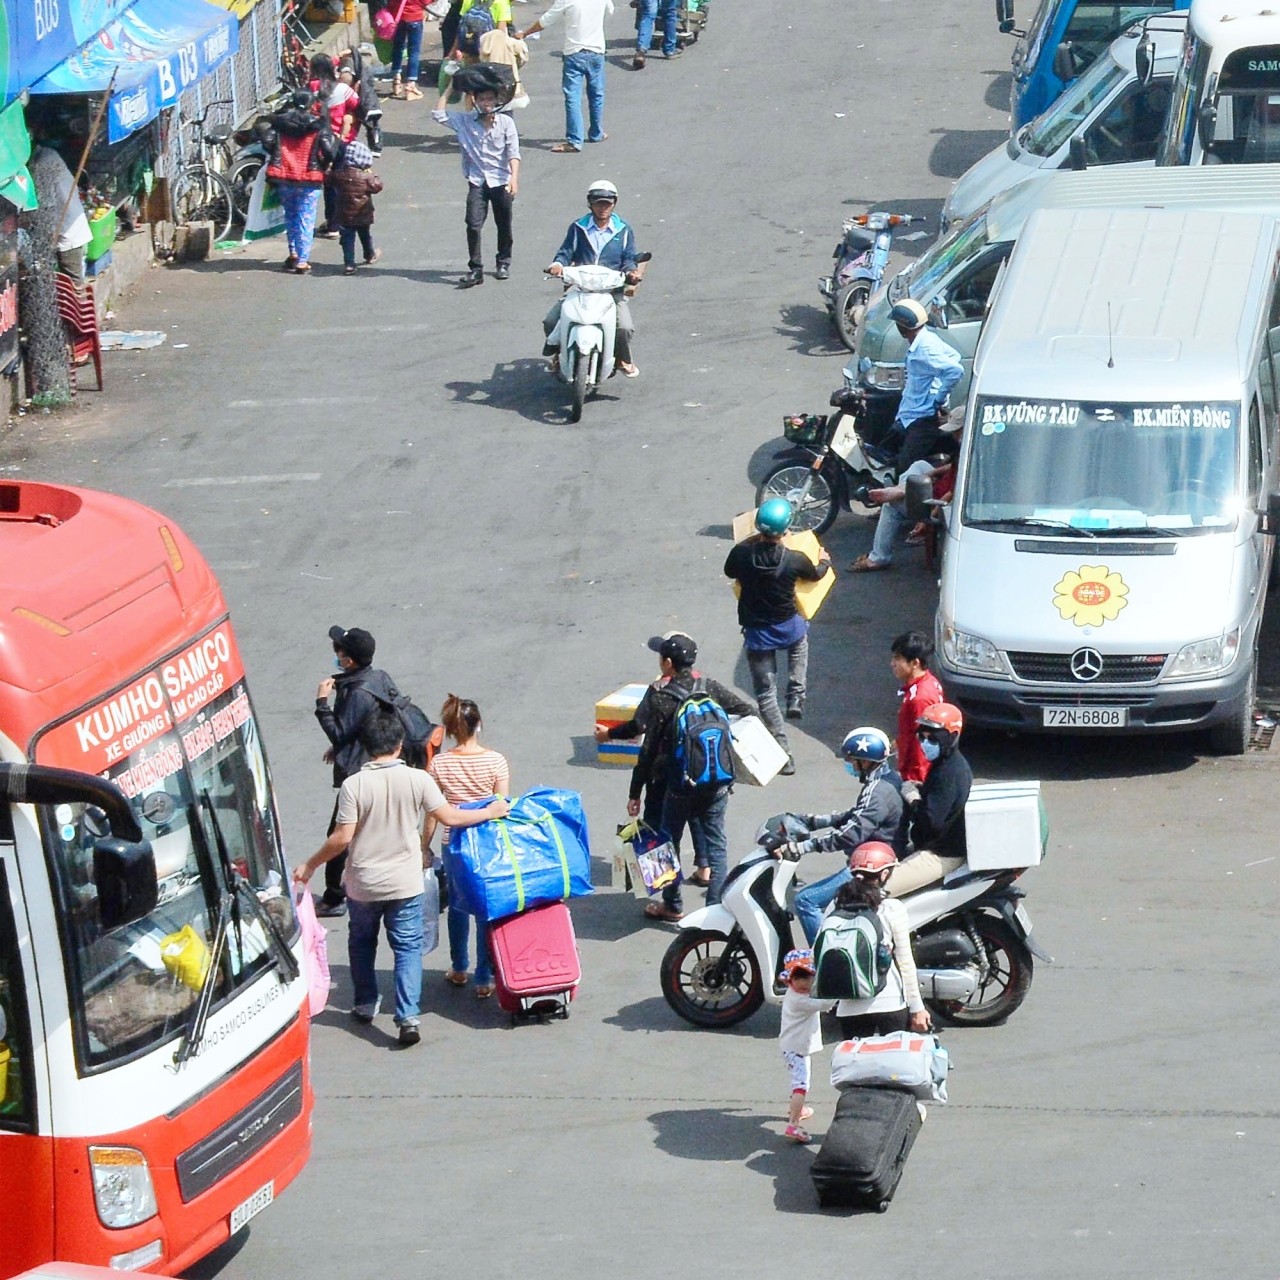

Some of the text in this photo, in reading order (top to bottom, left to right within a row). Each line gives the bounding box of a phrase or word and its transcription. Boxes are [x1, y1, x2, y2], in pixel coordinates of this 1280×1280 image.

[982, 401, 1047, 425] BX.VŨNG
[1048, 402, 1081, 426] TÀU
[1192, 406, 1232, 430] ĐÔNG
[74, 631, 230, 753] KUMHO SAMCO
[104, 741, 121, 763] XE
[187, 685, 207, 711] CAO
[206, 672, 224, 696] CẤP
[1048, 710, 1120, 725] 72N-6808
[219, 983, 281, 1042] SAMCO BUSLINES
